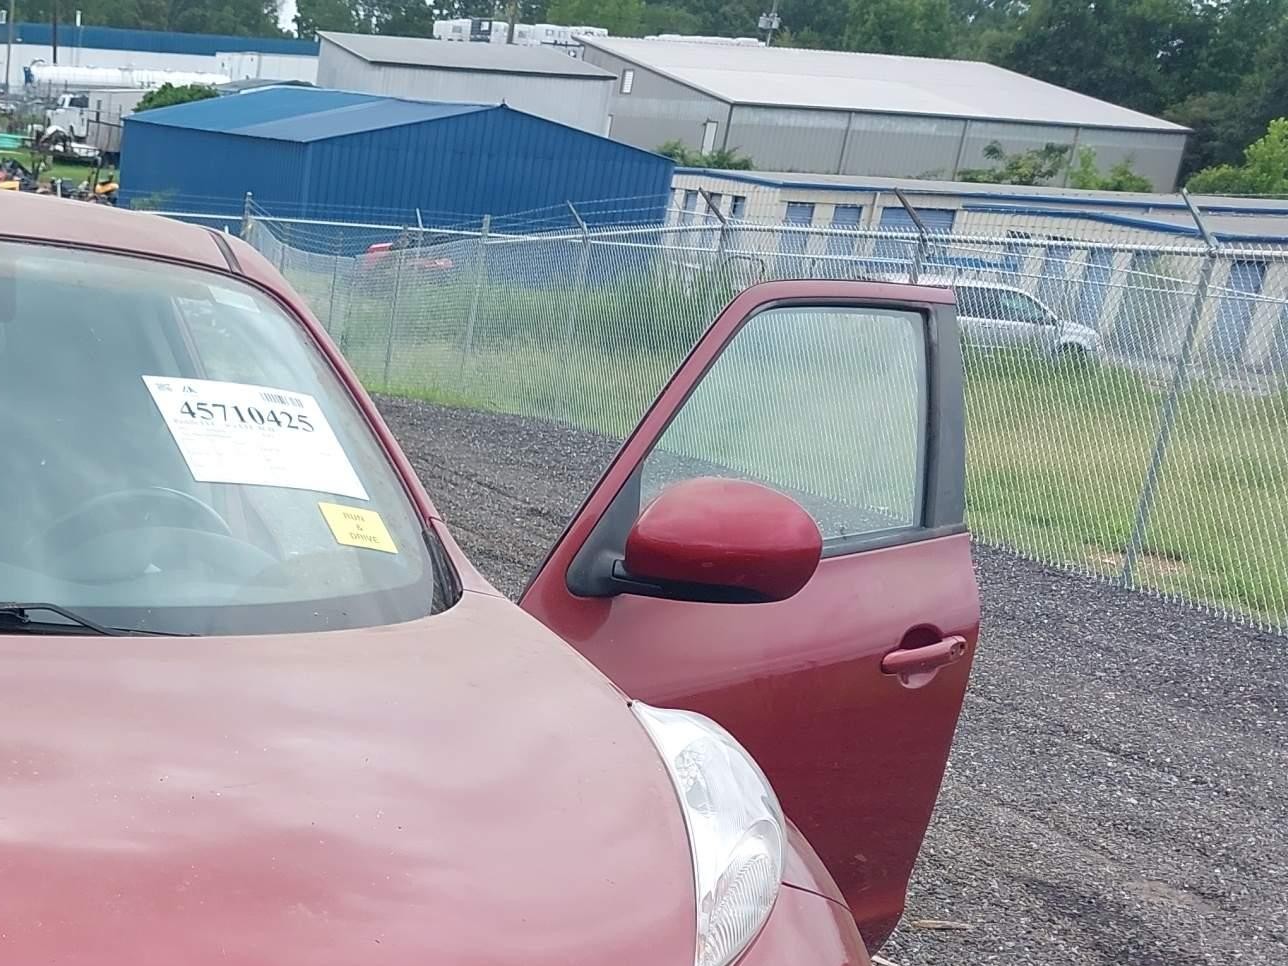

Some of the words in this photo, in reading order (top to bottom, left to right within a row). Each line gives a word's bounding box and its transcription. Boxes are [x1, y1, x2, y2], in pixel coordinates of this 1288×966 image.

[179, 400, 315, 432] 45710425
[342, 511, 366, 523] RUN
[349, 532, 381, 544] DRIVE
